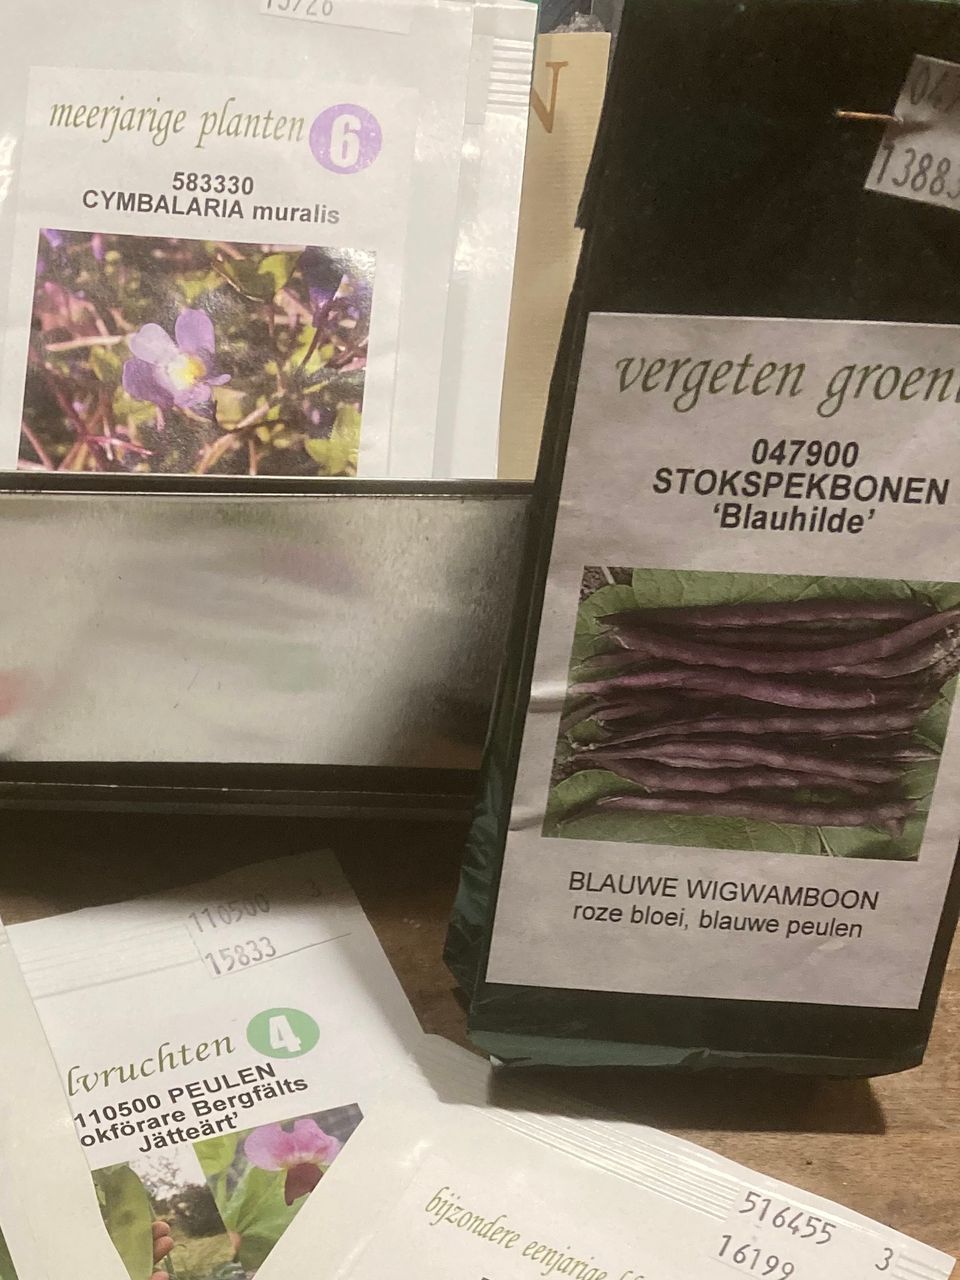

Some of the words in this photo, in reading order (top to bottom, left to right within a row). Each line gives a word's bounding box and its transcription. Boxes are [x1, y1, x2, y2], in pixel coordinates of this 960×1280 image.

[48, 97, 187, 146] meerjarige
[200, 98, 305, 149] planten
[329, 113, 361, 168] 6
[171, 171, 255, 197] 583330
[81, 188, 245, 221] CYMBALARIA
[252, 201, 340, 226] muralis
[615, 353, 806, 414] vergeten
[816, 364, 960, 418] groen
[751, 438, 860, 467] 047900
[652, 467, 950, 505] STOKSPEKBONEN
[568, 870, 679, 899] BLAUWE
[687, 878, 880, 912] WIGWAMBOON
[188, 893, 270, 933] 110500
[572, 902, 623, 923] roze
[630, 903, 689, 930] bloei,
[698, 910, 780, 935] blauwe
[785, 918, 863, 940] peulen
[205, 936, 277, 975] 15833
[268, 1014, 303, 1053] 4
[67, 1033, 236, 1097] lvruchten
[73, 1094, 161, 1128] 110500
[167, 1061, 277, 1104] PEULEN
[80, 1109, 186, 1147] okförare
[192, 1074, 310, 1118] Bergfälts
[138, 1111, 238, 1153] Jätteärt’
[424, 1187, 521, 1249] bijzondere
[739, 1190, 837, 1245] 516455
[875, 1246, 894, 1272] 3
